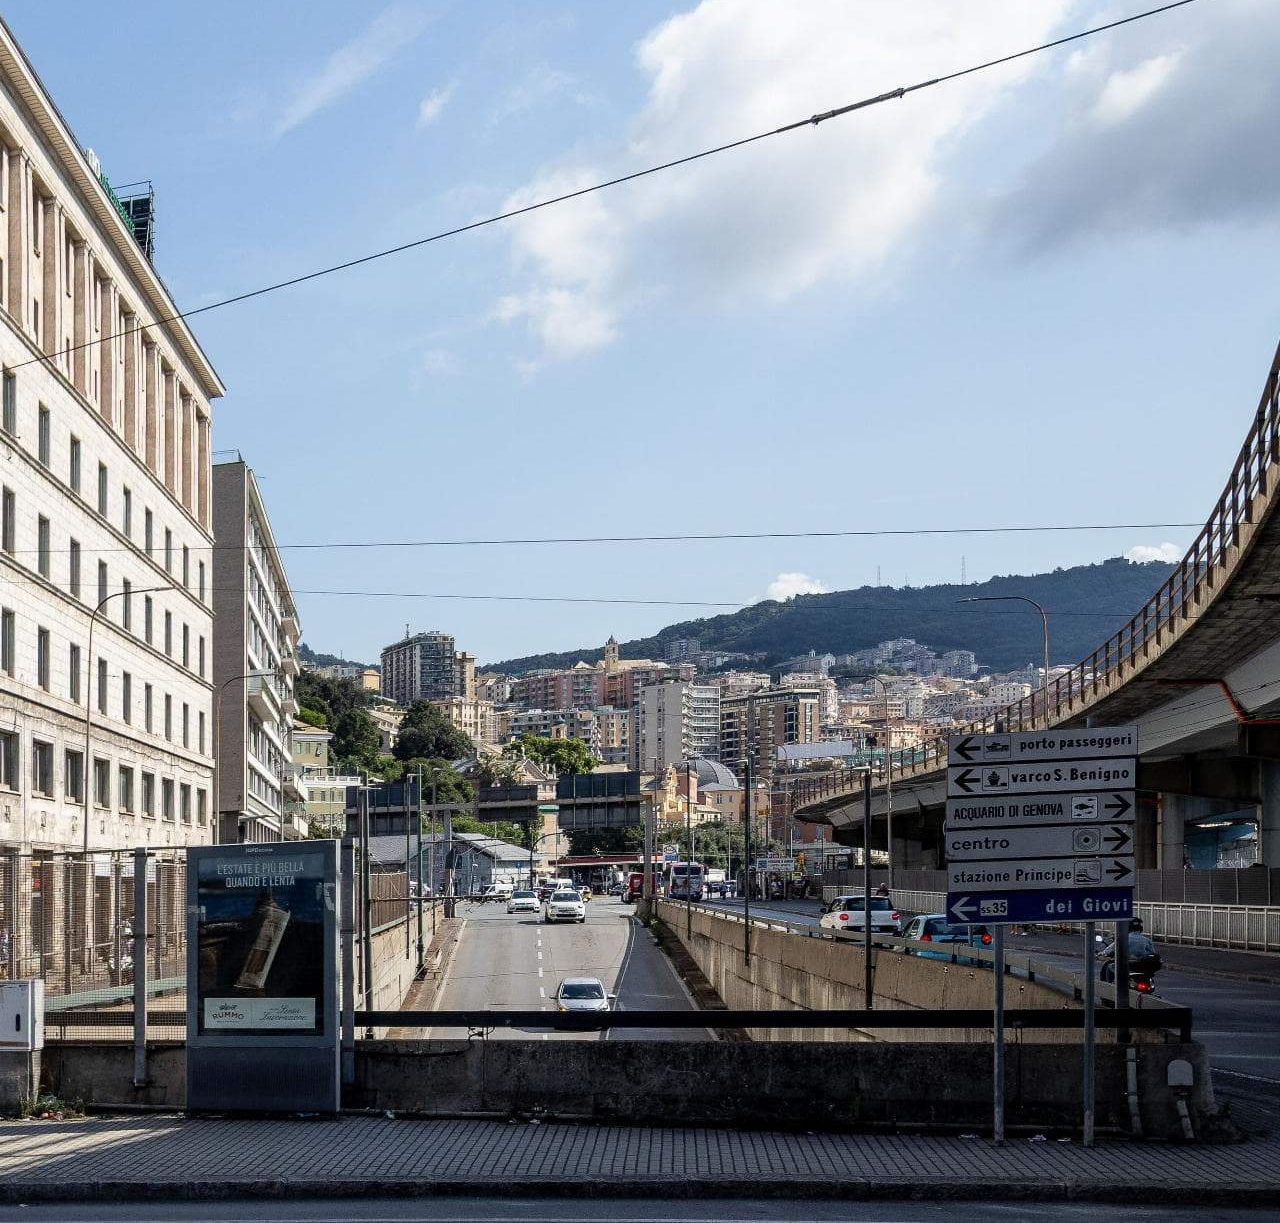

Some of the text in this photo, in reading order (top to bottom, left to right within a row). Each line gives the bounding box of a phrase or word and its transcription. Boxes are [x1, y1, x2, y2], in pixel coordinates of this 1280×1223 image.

[1020, 733, 1132, 752] porto passeggeri
[1011, 767, 1130, 783] varco S. Benigno
[953, 802, 1064, 821] ACQUARIO DI GENOVA
[951, 837, 1010, 851] centro
[217, 863, 253, 875] L'ESTATE
[278, 861, 304, 873] BELLA
[953, 868, 1072, 883] stazione Principe
[225, 876, 260, 888] QUANDO
[270, 875, 296, 886] LENTA
[1045, 897, 1128, 914] dei Giovi
[212, 1011, 245, 1020] RUMMO
